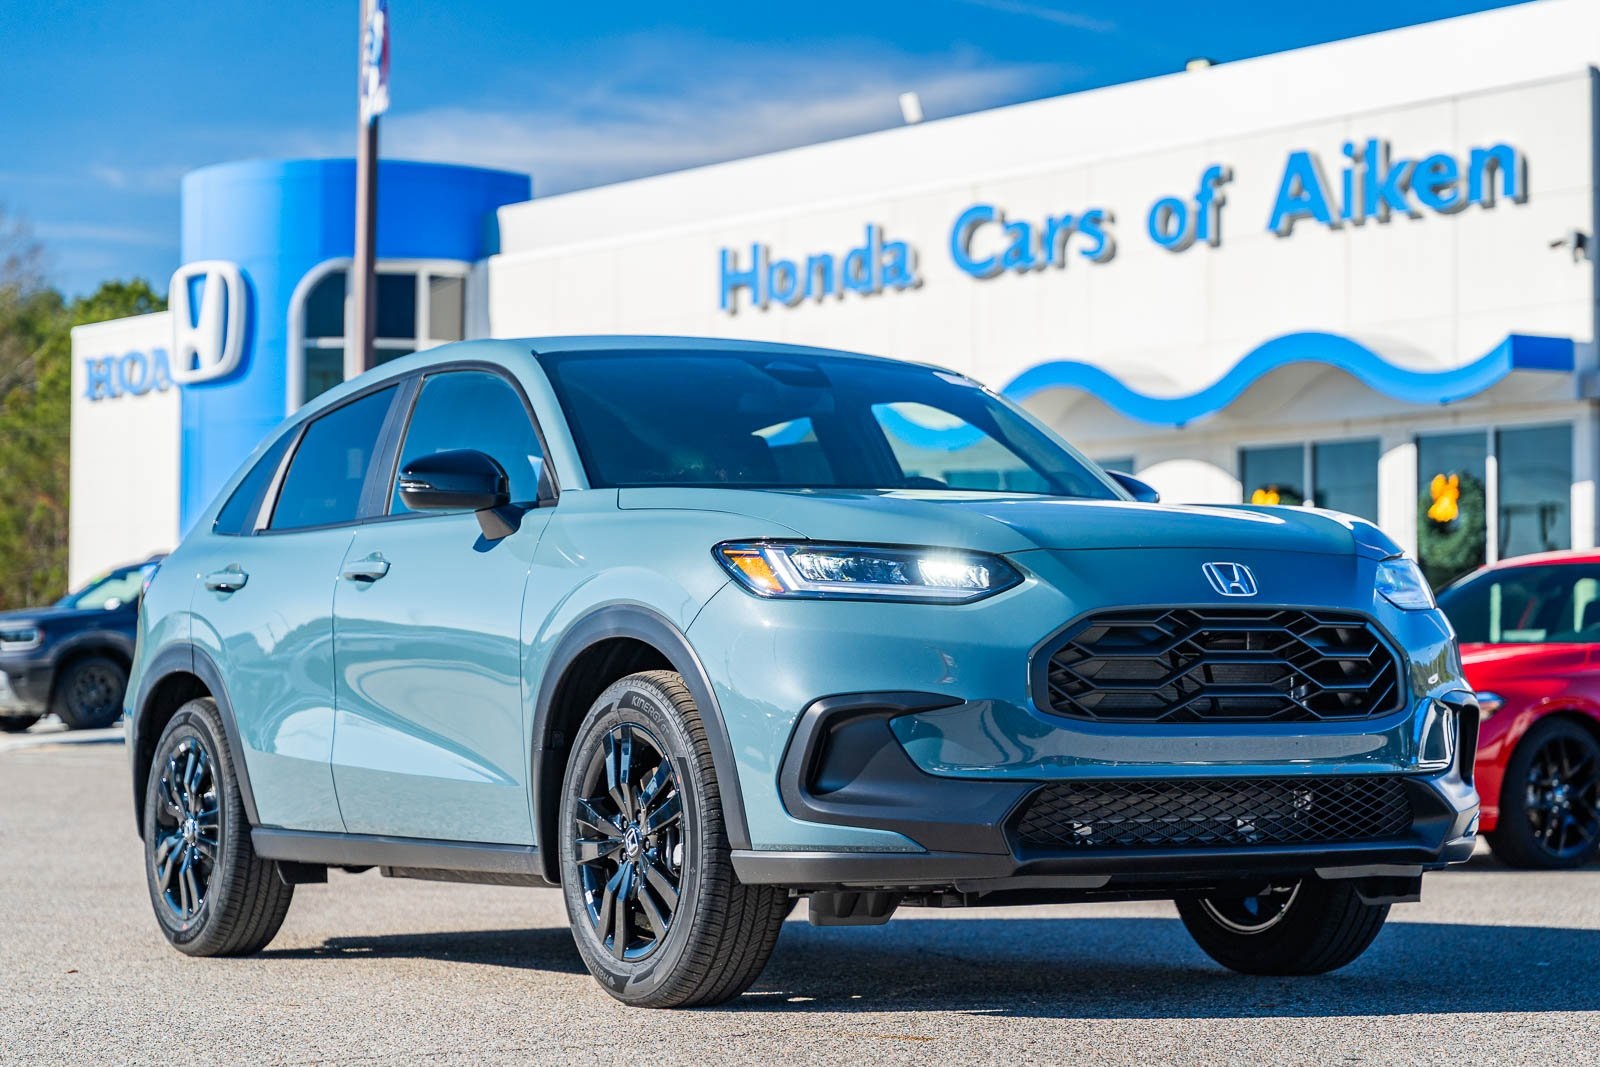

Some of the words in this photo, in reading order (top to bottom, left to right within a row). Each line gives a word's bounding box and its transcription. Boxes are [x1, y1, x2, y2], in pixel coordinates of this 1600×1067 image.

[718, 224, 922, 314] Honda
[950, 204, 1115, 279] Cars
[1148, 165, 1233, 251] of
[1268, 137, 1528, 236] Aiken
[84, 348, 173, 401] HON
